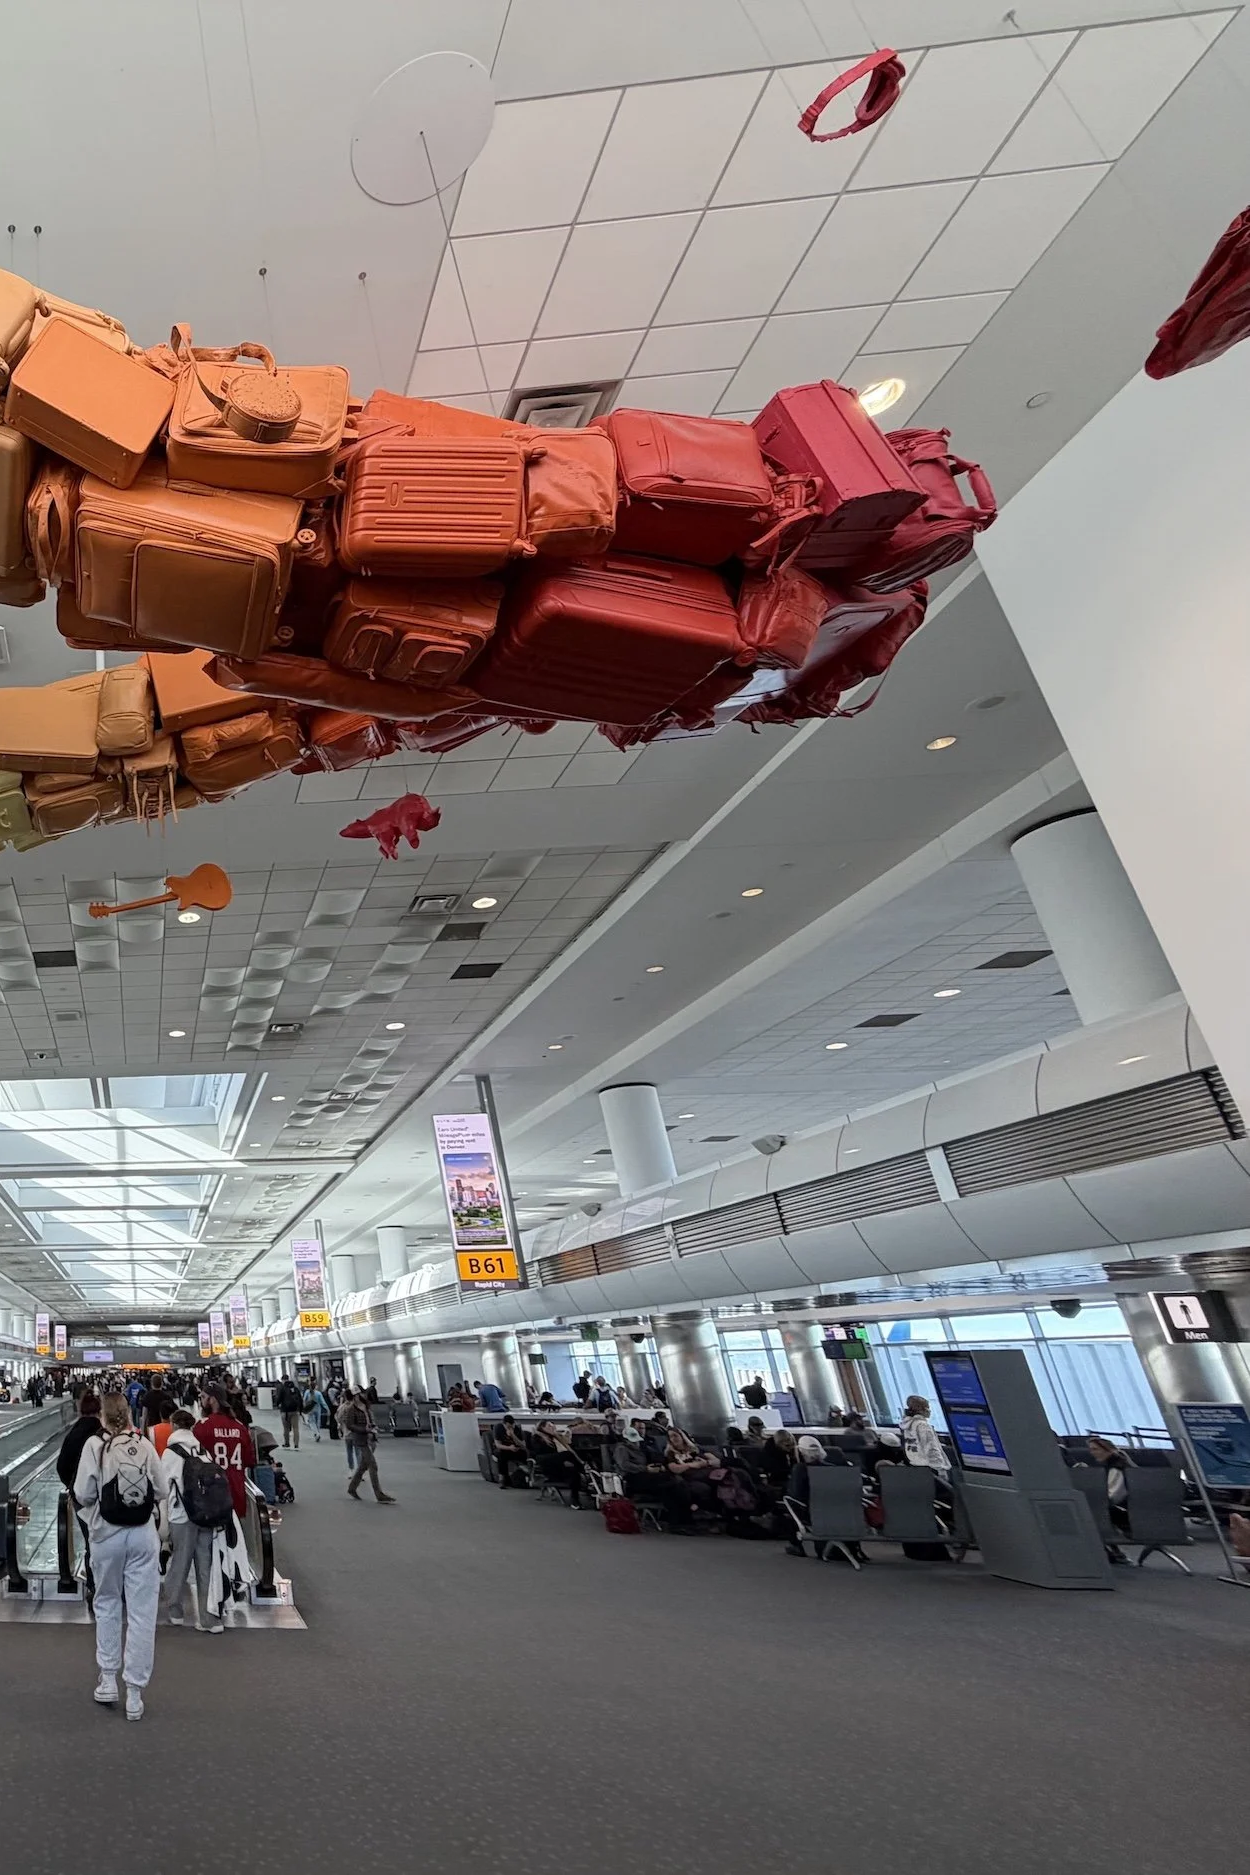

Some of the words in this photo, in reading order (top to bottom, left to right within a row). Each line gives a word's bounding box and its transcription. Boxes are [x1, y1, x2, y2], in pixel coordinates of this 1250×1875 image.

[468, 1257, 505, 1274] B61
[304, 1313, 324, 1323] B59
[1184, 1330, 1209, 1340] Men
[213, 1427, 241, 1438] BALLARD
[213, 1441, 243, 1471] 84
